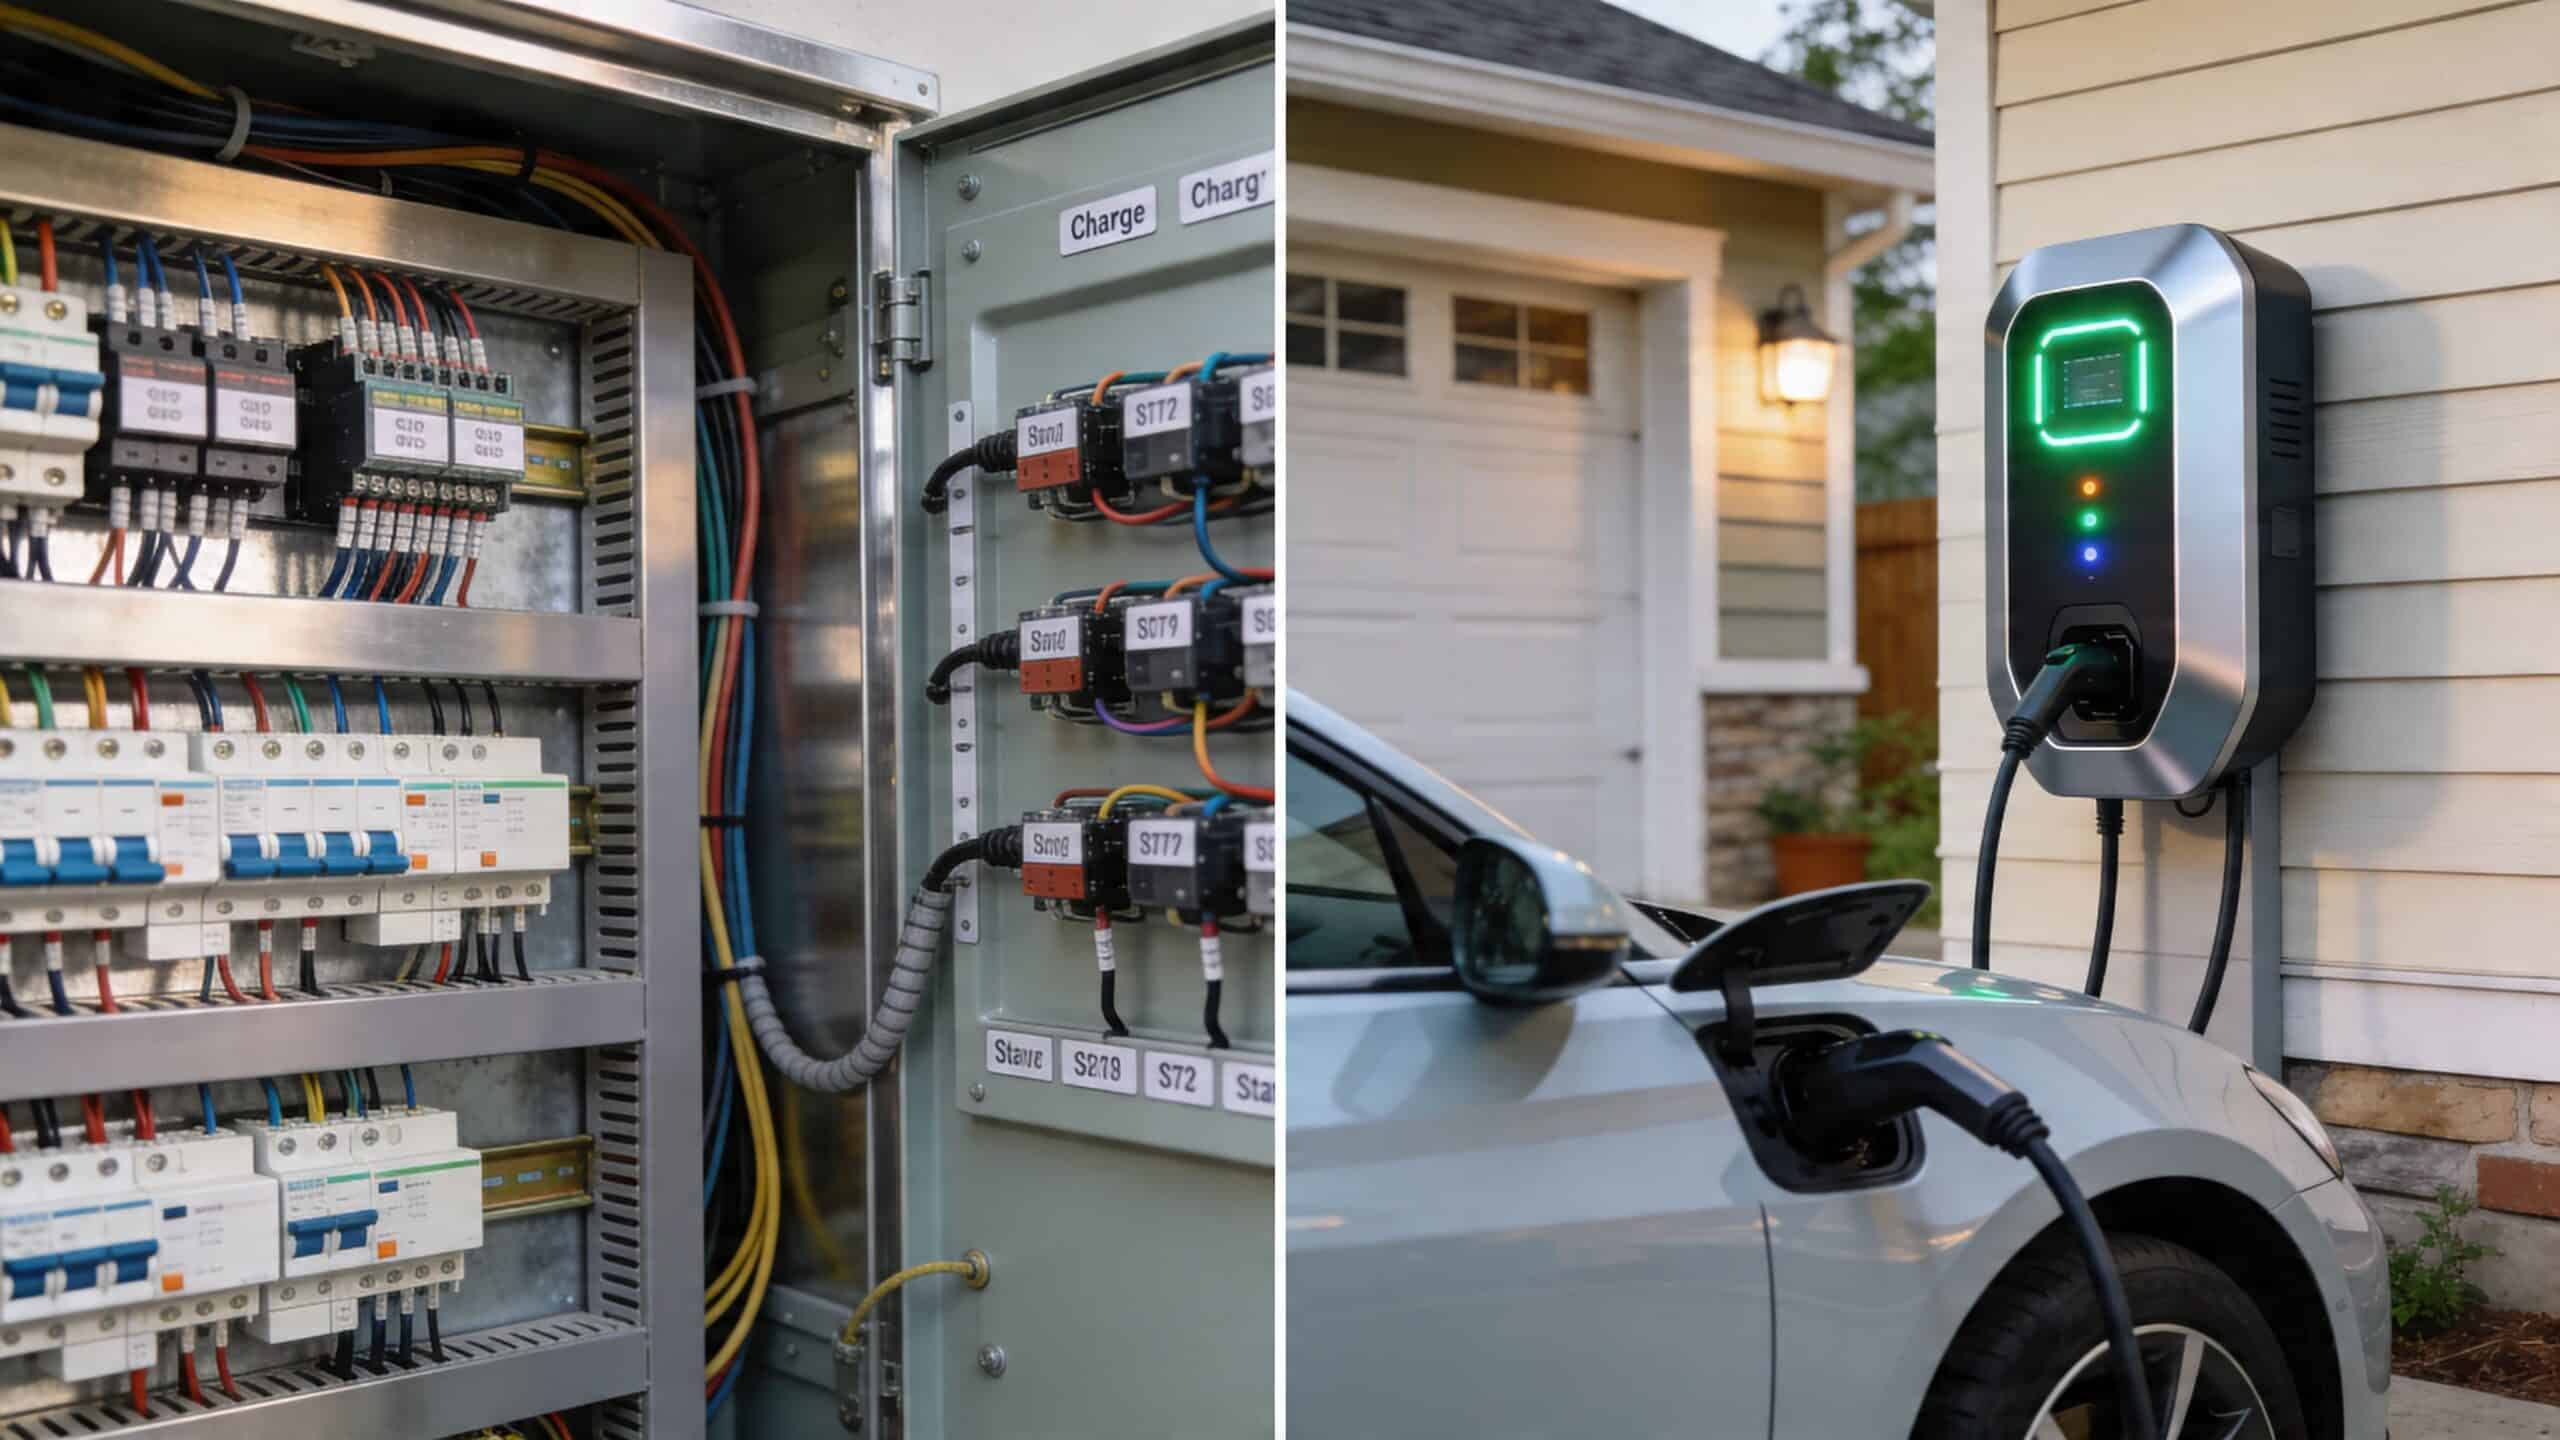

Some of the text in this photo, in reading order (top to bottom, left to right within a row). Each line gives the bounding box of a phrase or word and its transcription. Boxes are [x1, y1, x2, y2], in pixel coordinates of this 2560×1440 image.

[1192, 169, 1267, 208] Charg
[1071, 204, 1146, 240] Charge
[1158, 1062, 1197, 1093] S72
[1236, 1072, 1275, 1104] Sta
